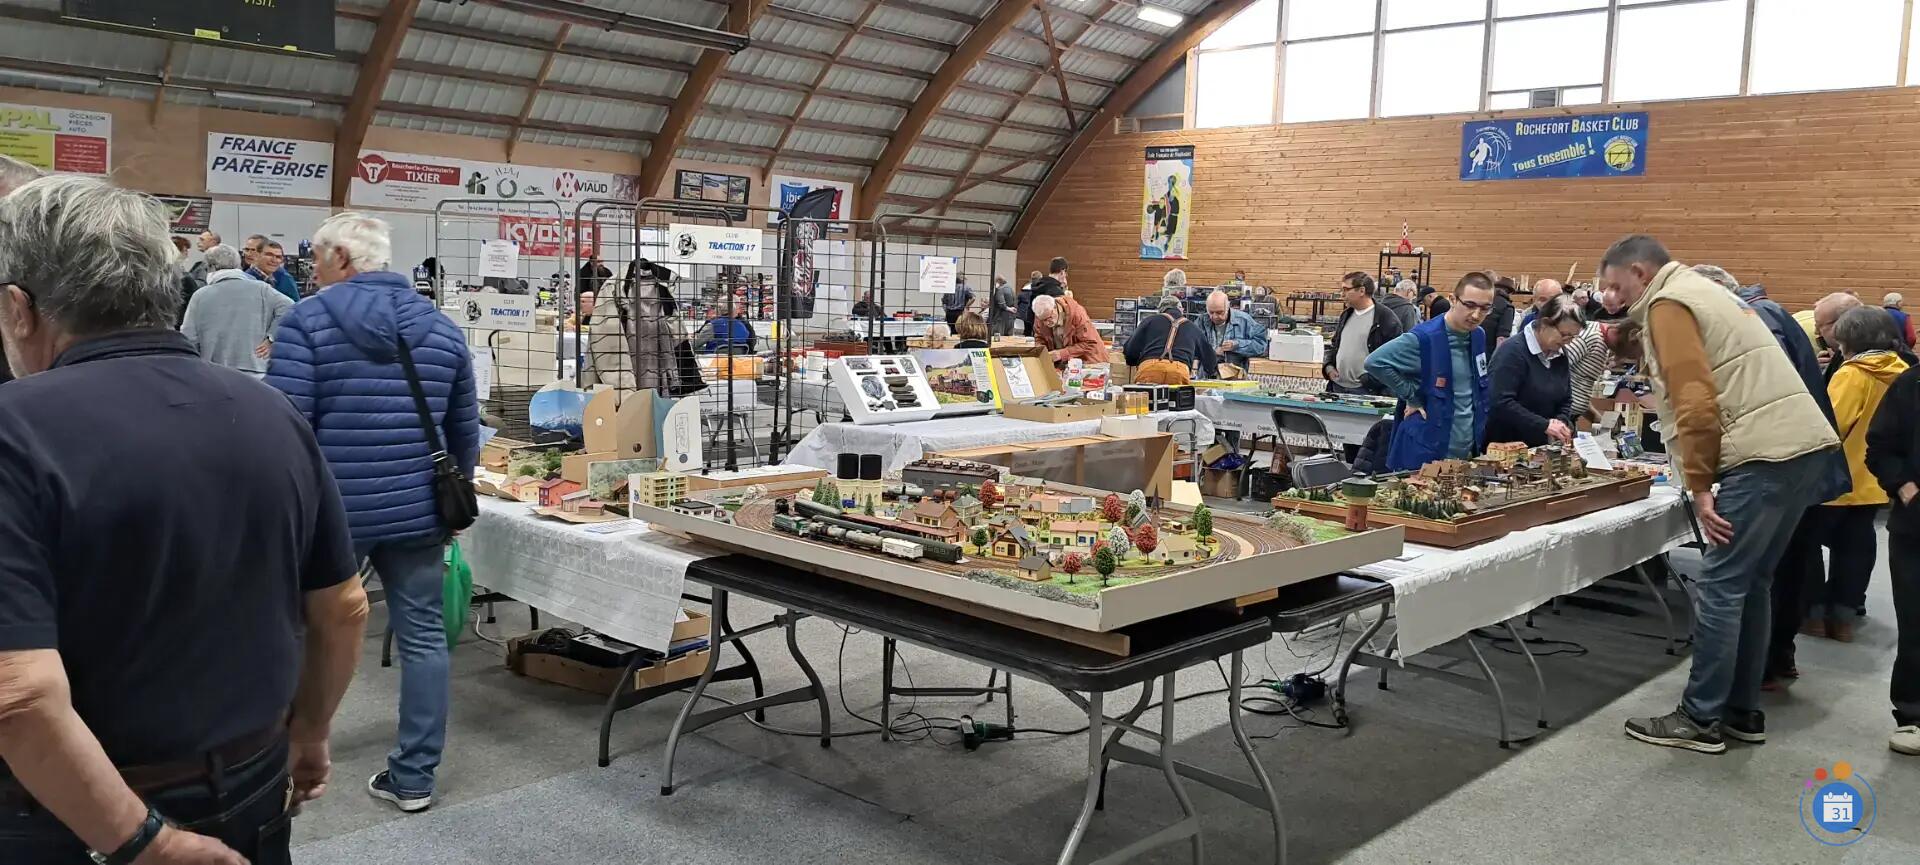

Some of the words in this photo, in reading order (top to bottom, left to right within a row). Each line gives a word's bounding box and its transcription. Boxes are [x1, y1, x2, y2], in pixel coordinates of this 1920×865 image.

[0, 108, 61, 131] PAL
[1515, 121, 1569, 136] ROCHEFORT
[1571, 118, 1610, 133] BASKET
[1611, 116, 1639, 131] CLUB
[220, 136, 296, 155] FRANCE
[1512, 158, 1536, 172] Tous
[1537, 142, 1586, 166] Ensemble
[211, 156, 328, 179] PARE-BRISE
[369, 166, 378, 179] T
[405, 170, 441, 183] TIXIER
[578, 181, 608, 193] VIAUD
[505, 222, 593, 250] KYOSHO
[708, 241, 745, 251] TRACTION
[746, 244, 756, 252] 17
[490, 307, 520, 317] TRACTION
[521, 310, 530, 318] 17
[971, 350, 987, 358] TRIX
